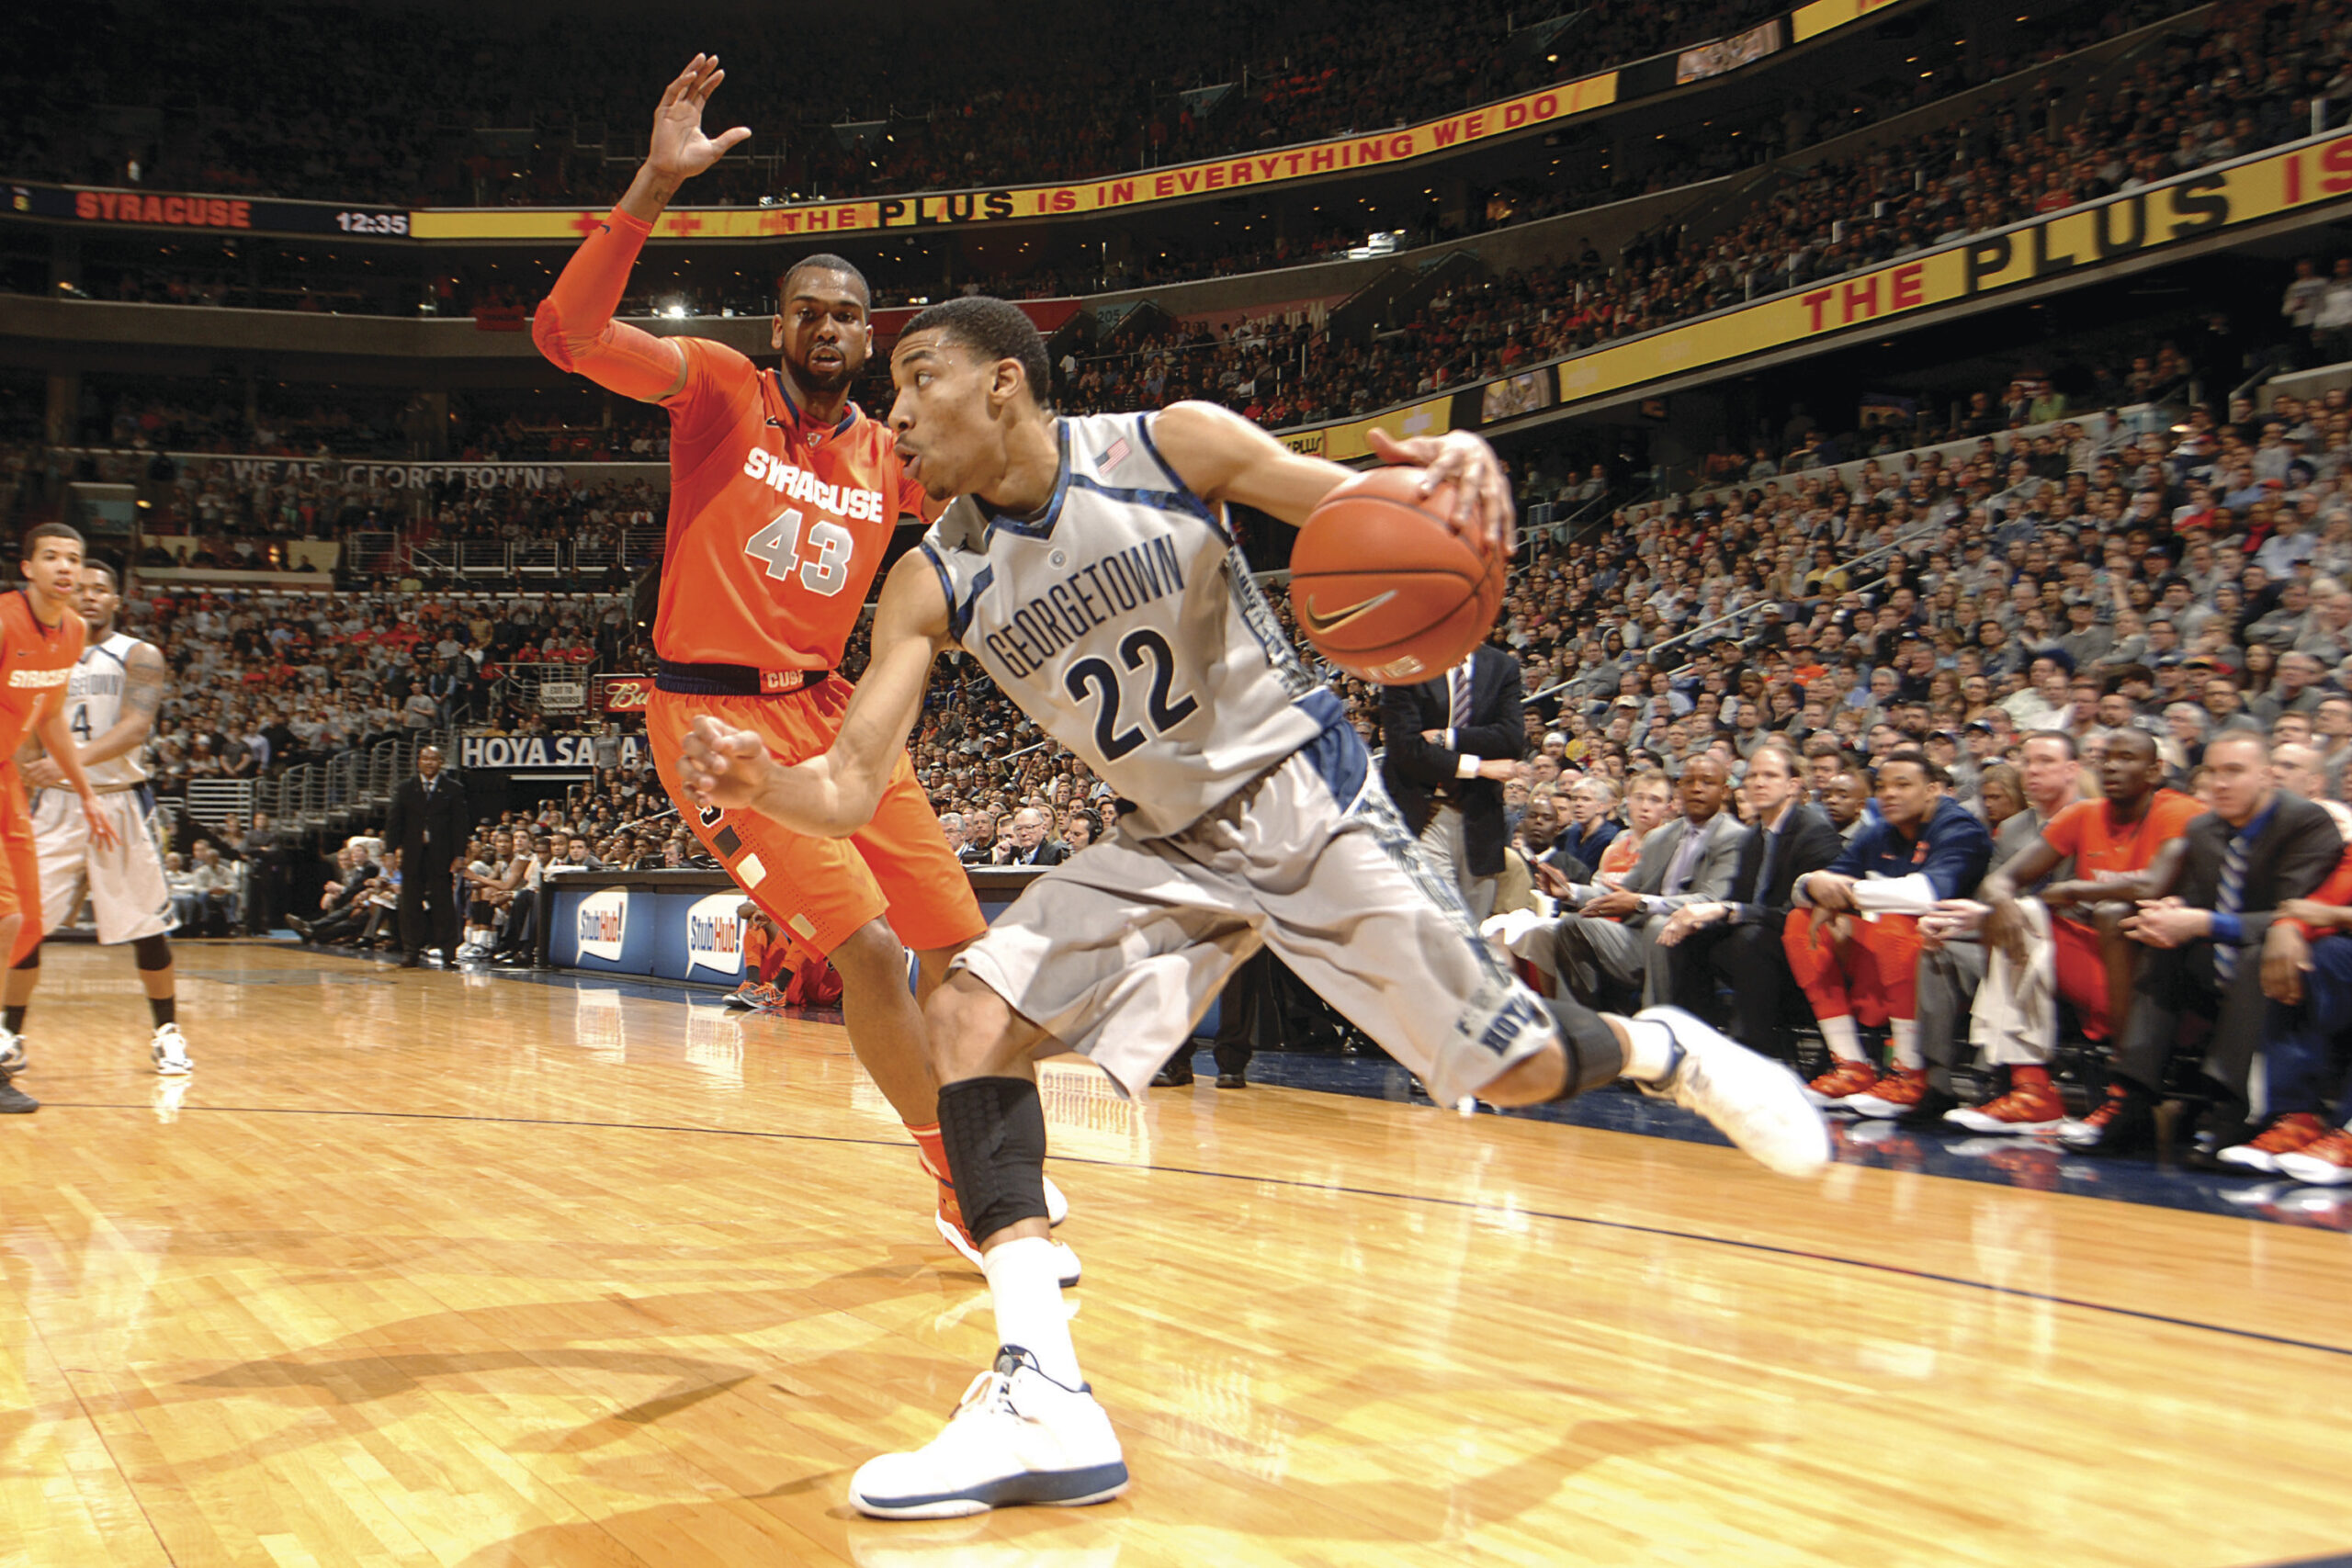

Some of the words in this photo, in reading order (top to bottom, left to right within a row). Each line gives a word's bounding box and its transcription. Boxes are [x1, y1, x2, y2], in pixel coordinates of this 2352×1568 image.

[782, 208, 856, 232] THE
[879, 191, 1014, 229] PLUS
[1037, 189, 1077, 213] IS
[1098, 181, 1135, 207] IN
[1155, 133, 1414, 197] EVERYTHING
[1432, 113, 1485, 148] WE
[1503, 94, 1558, 129] DO
[75, 191, 252, 229] SYRACUSE
[335, 211, 408, 235] 12:35
[1802, 263, 1923, 333] THE
[1963, 172, 2232, 293] PLUS
[2284, 138, 2352, 205] IS
[743, 446, 883, 524] SYRACUSE
[744, 507, 854, 597] 43
[986, 534, 1184, 679] GEORGETOWN
[71, 703, 92, 741] 4
[1062, 626, 1202, 765] 22
[461, 737, 548, 766] HOYA
[555, 737, 639, 766] SAA
[580, 901, 624, 942] StubHub!
[691, 915, 741, 953] StubHub!
